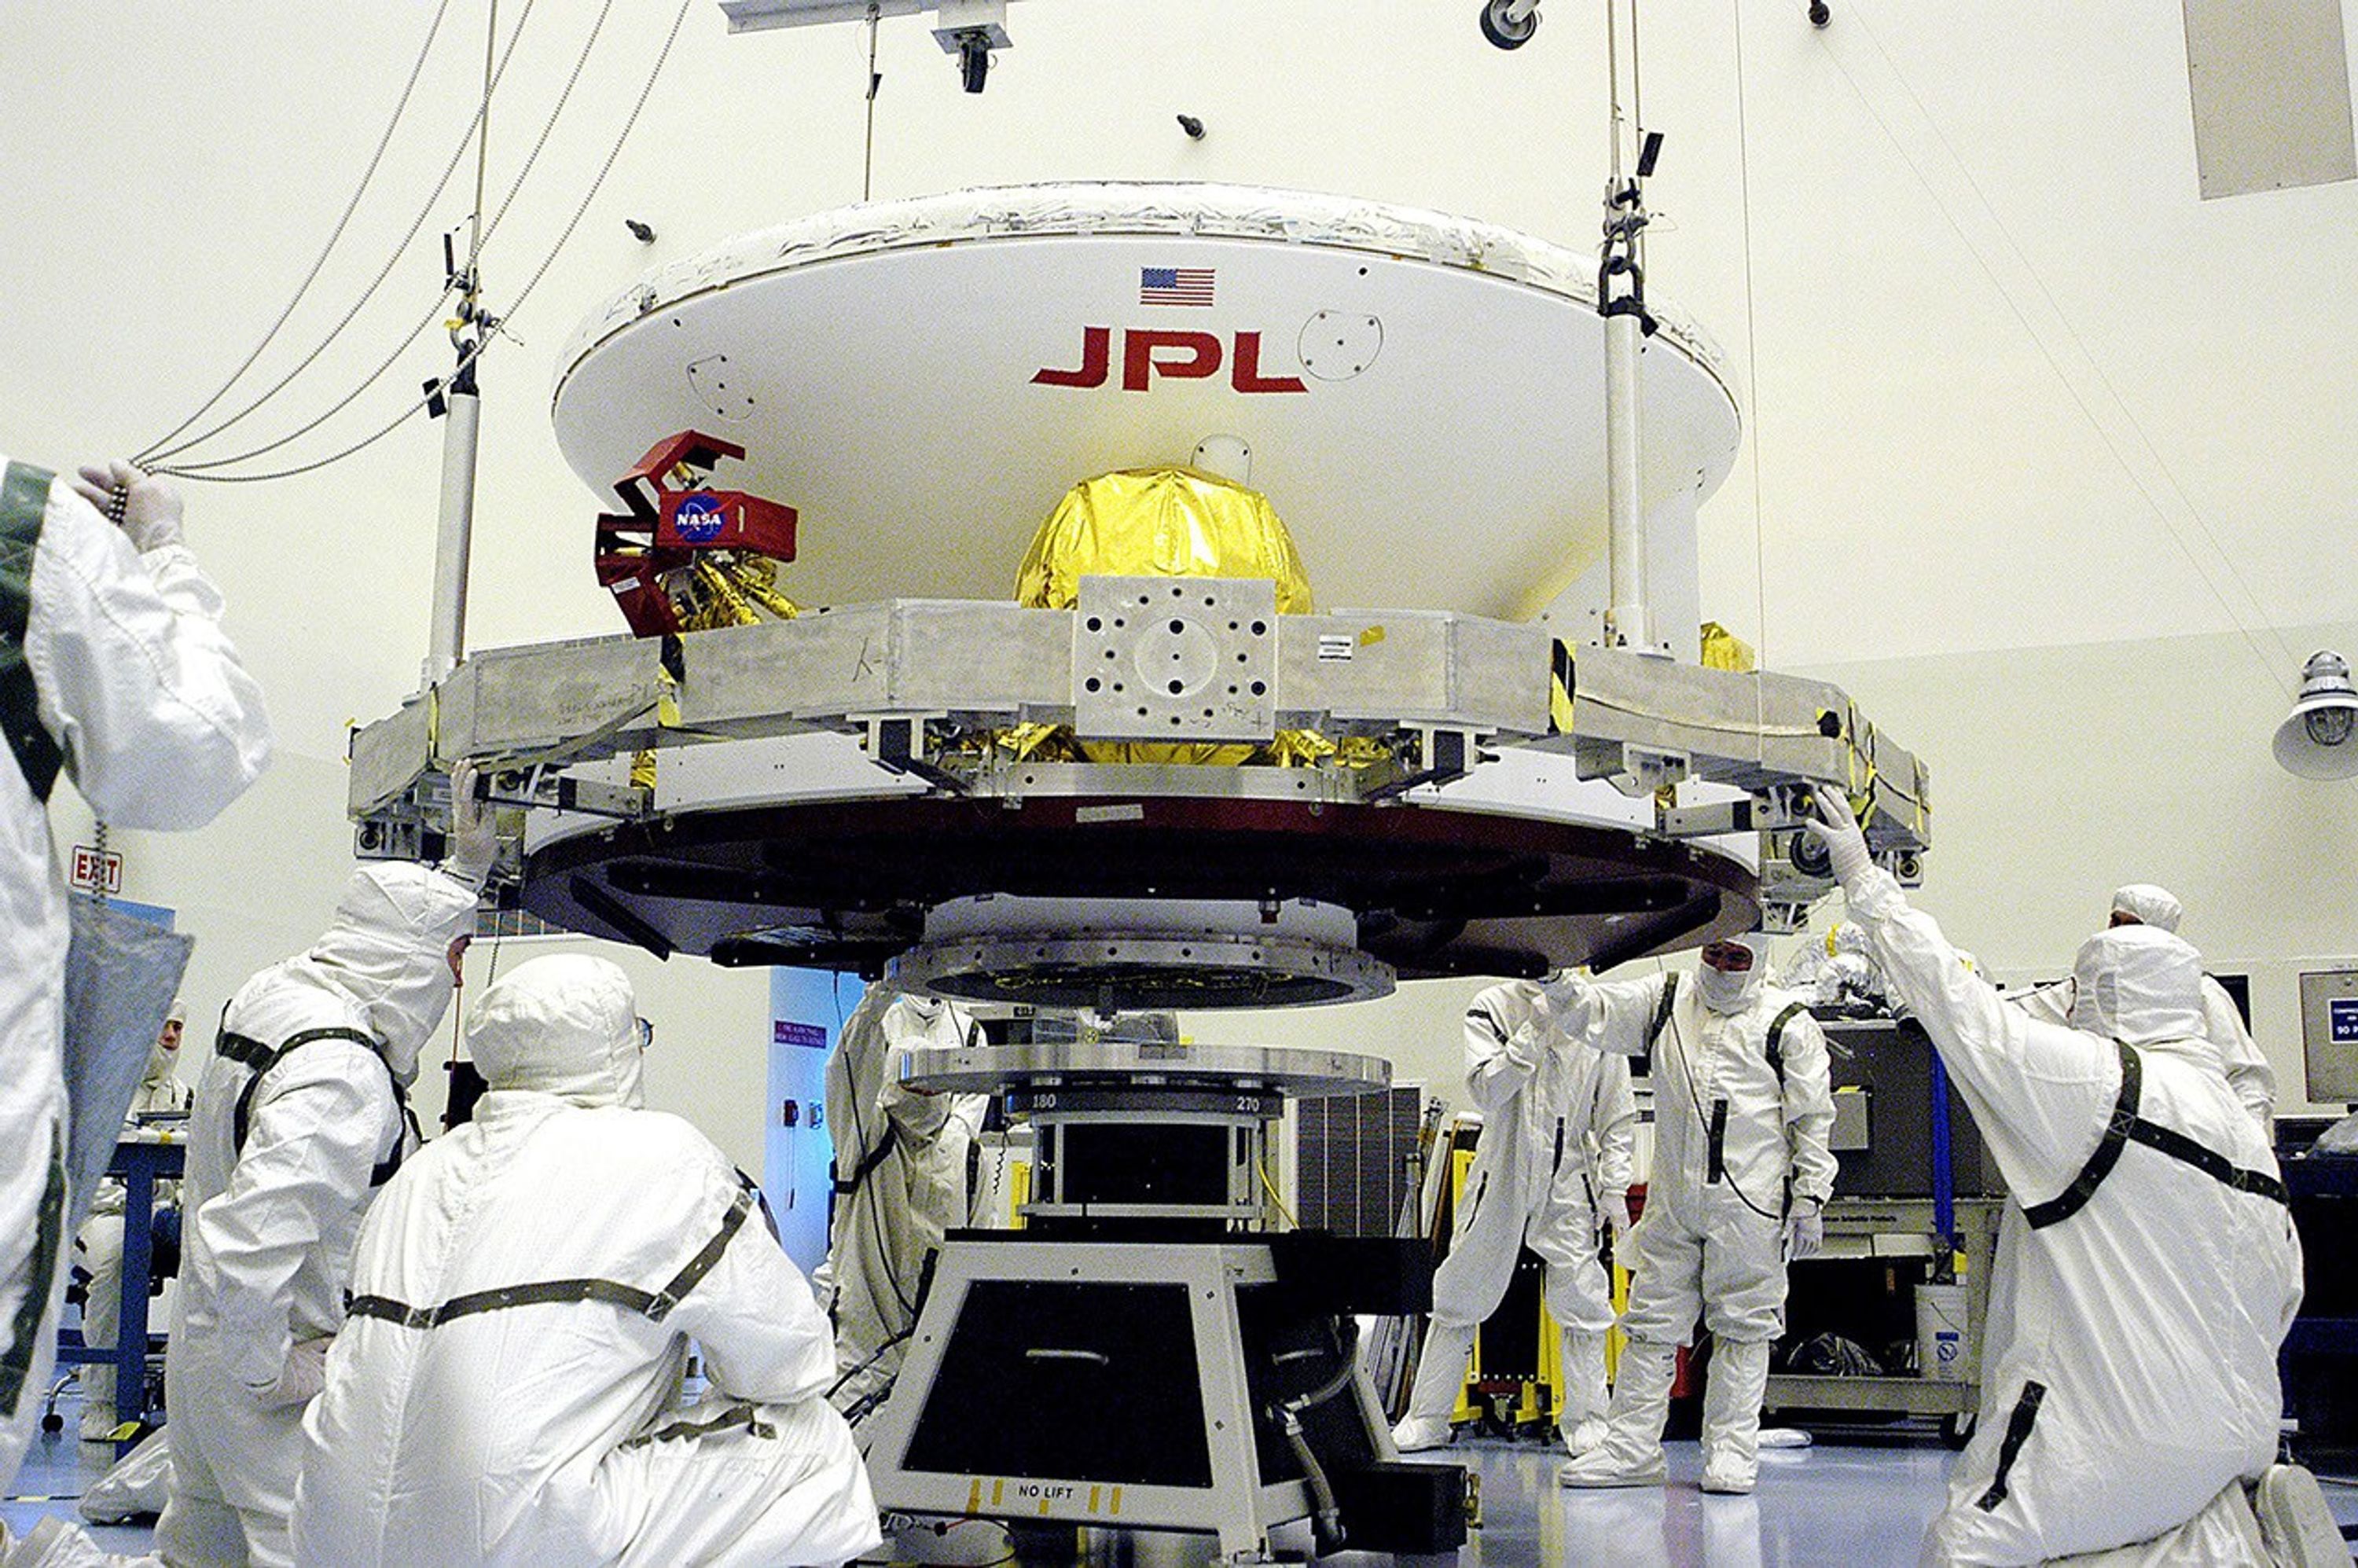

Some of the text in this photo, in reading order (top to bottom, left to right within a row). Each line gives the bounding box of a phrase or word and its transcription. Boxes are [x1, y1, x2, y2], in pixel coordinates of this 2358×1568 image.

[1029, 326, 1309, 393] JPL
[677, 513, 722, 526] NASA
[1033, 1092, 1056, 1108] 180
[1236, 1096, 1260, 1112] 270
[1019, 1485, 1074, 1499] NO LIFT
